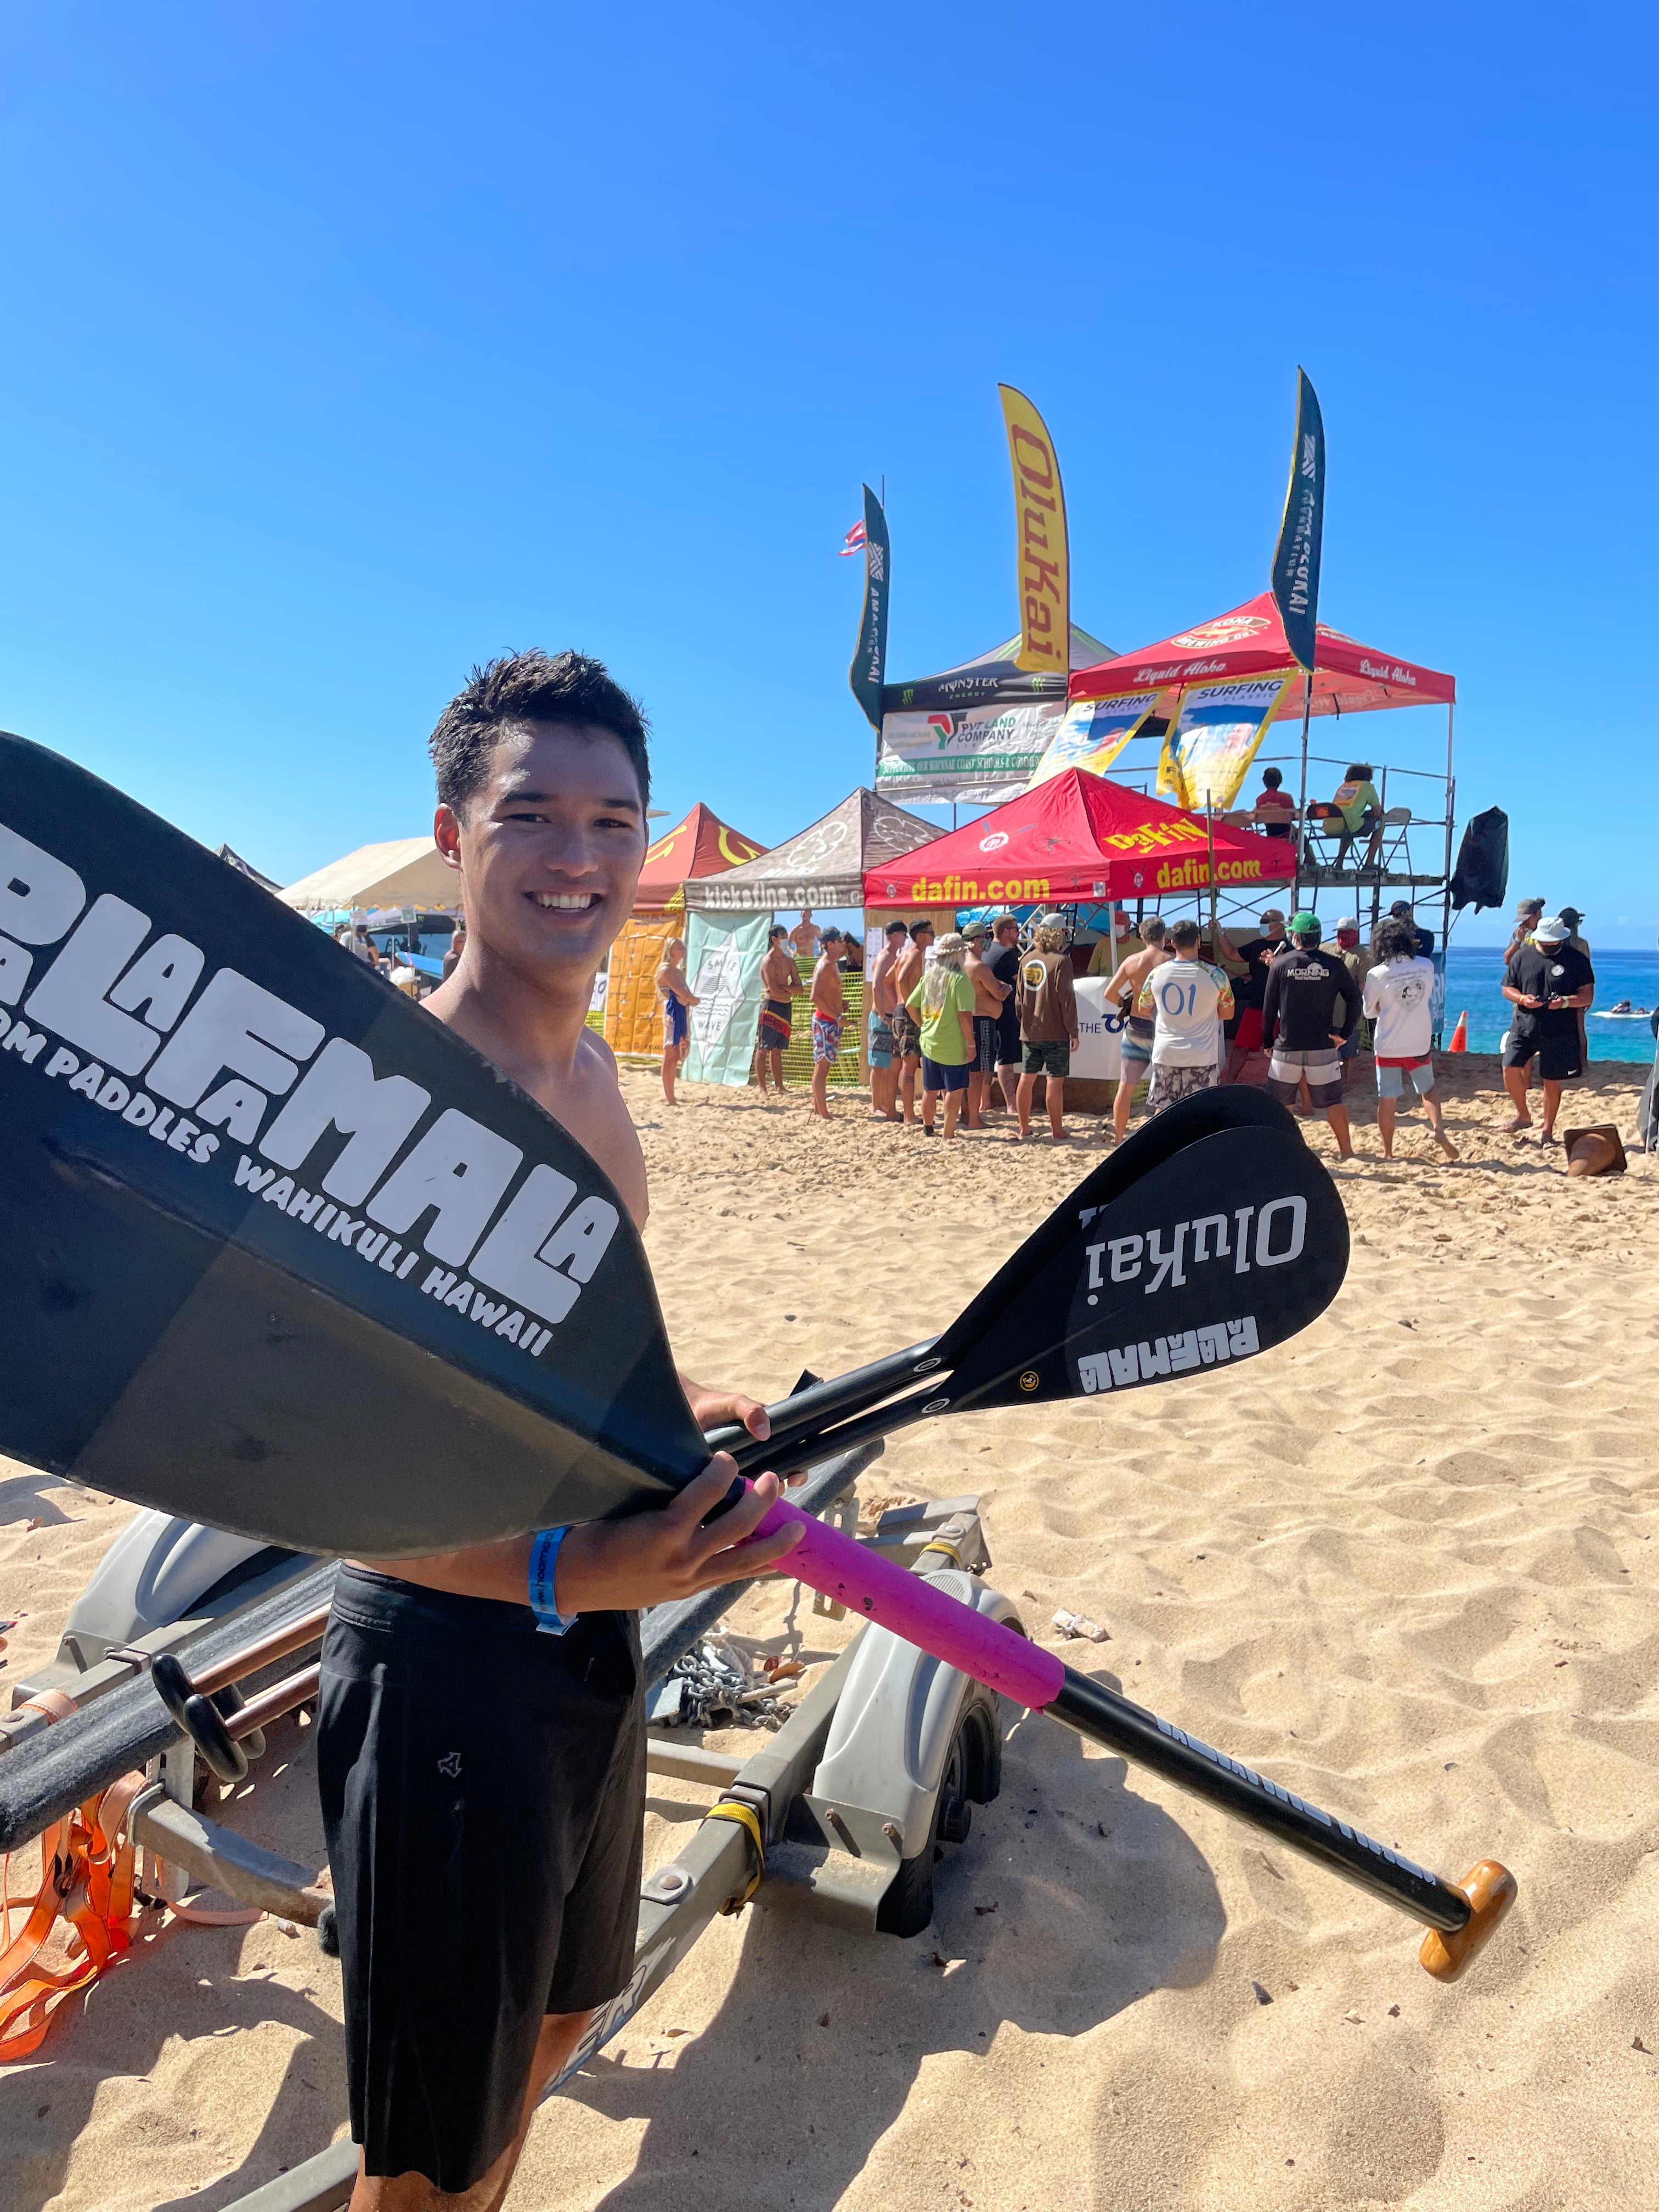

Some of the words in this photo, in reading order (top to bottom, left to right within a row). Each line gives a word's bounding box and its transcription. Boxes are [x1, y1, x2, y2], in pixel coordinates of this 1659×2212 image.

[1133, 665, 1179, 685] Liquid
[1183, 659, 1227, 676] Aloha
[1359, 659, 1389, 679] Liquid
[1392, 667, 1416, 686] Aloha
[1197, 680, 1284, 699] SURFING
[1223, 692, 1277, 702] CLASSIC
[1083, 693, 1159, 712] SURFING
[962, 721, 984, 732] PVT
[985, 717, 1017, 729] LAND
[957, 729, 1014, 742] COMPANY
[1156, 857, 1262, 889] dafin.com
[704, 883, 837, 909] kicksfins.com
[911, 875, 1050, 902] dafin.com
[707, 959, 737, 972] SMLE
[1286, 967, 1330, 978] MORNING
[698, 1020, 722, 1031] WAVE
[1079, 1022, 1102, 1034] THE
[44, 1046, 221, 1164] PADDLES
[233, 1154, 420, 1280] WAHIKULI
[420, 1265, 554, 1358] HAWAII
[1086, 1195, 1308, 1306] OluKai
